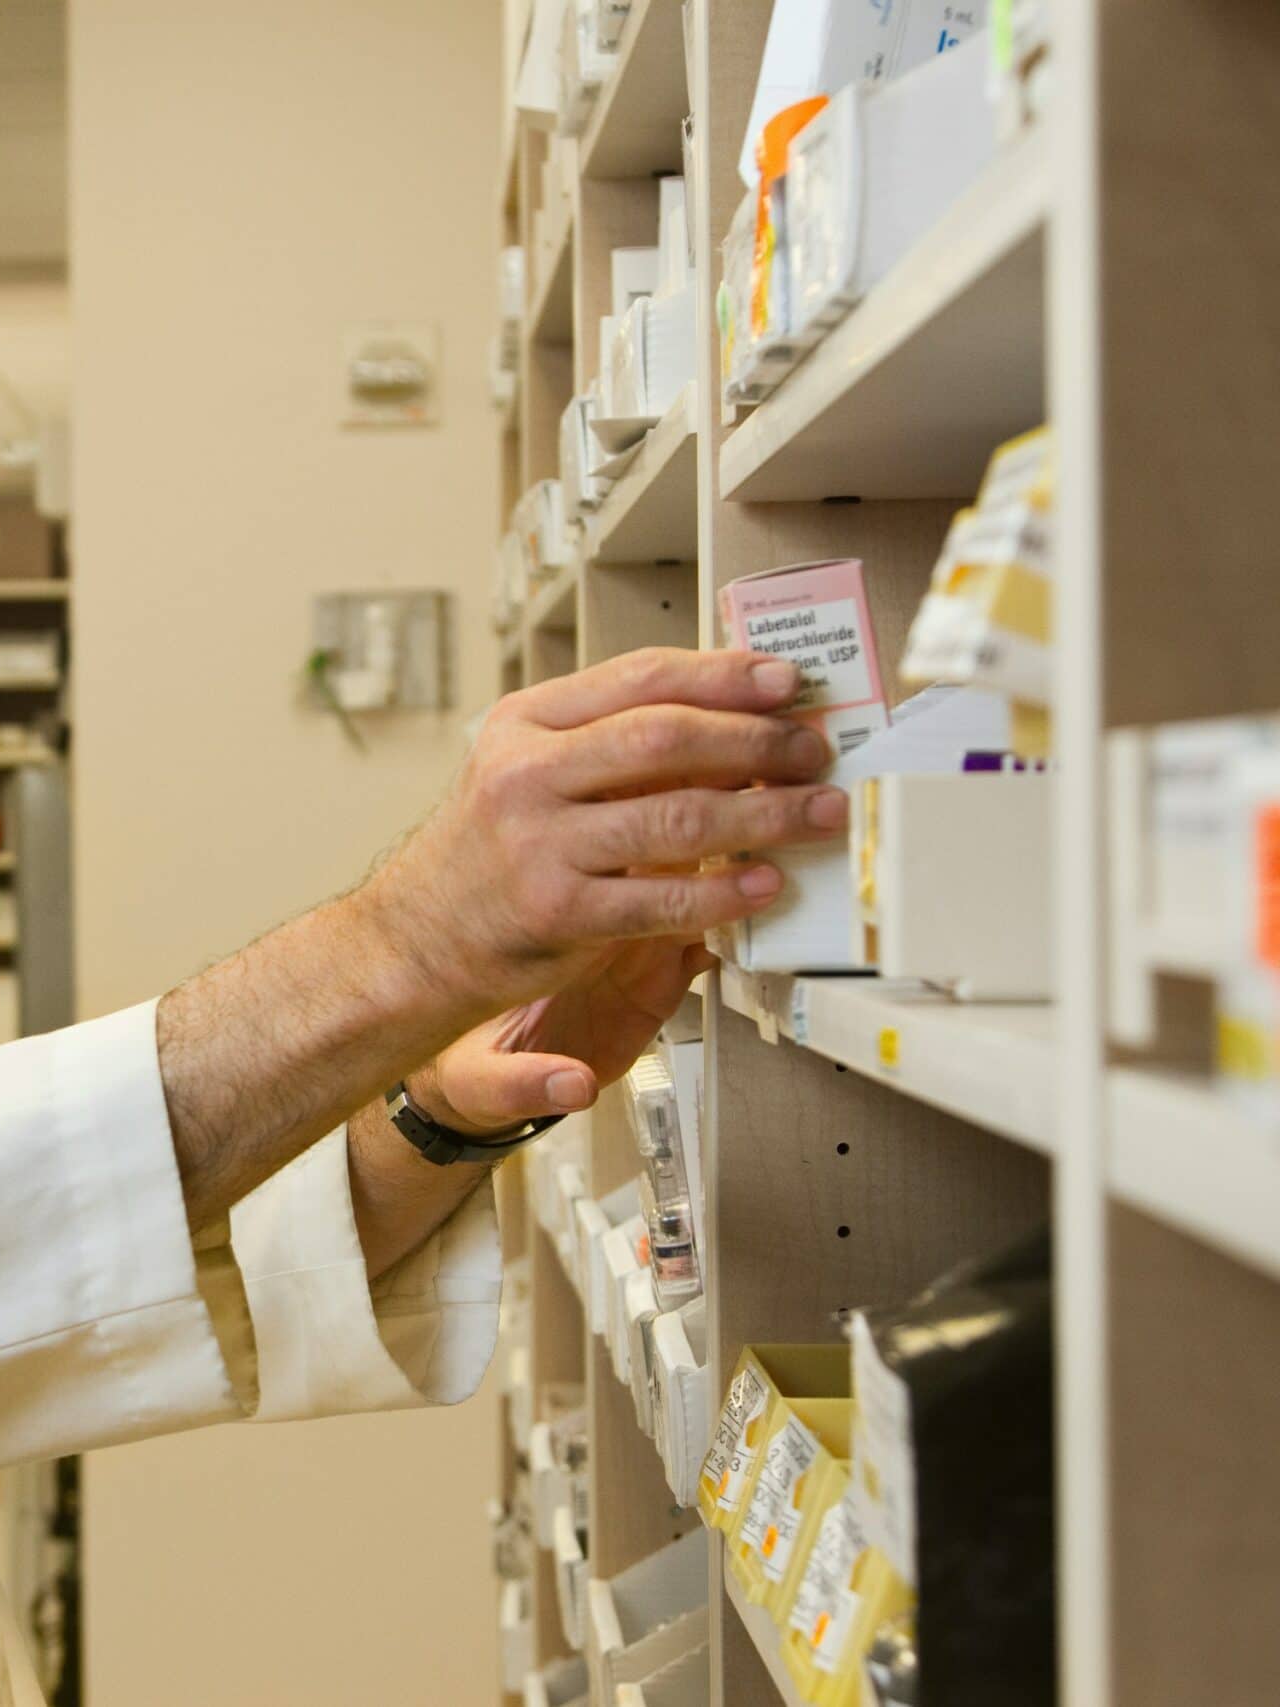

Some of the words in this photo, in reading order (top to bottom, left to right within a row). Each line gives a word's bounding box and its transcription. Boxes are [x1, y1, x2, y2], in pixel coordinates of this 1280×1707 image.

[747, 609, 816, 636] Labetalol
[751, 624, 856, 654] Hydrochloride
[827, 644, 860, 664] USP
